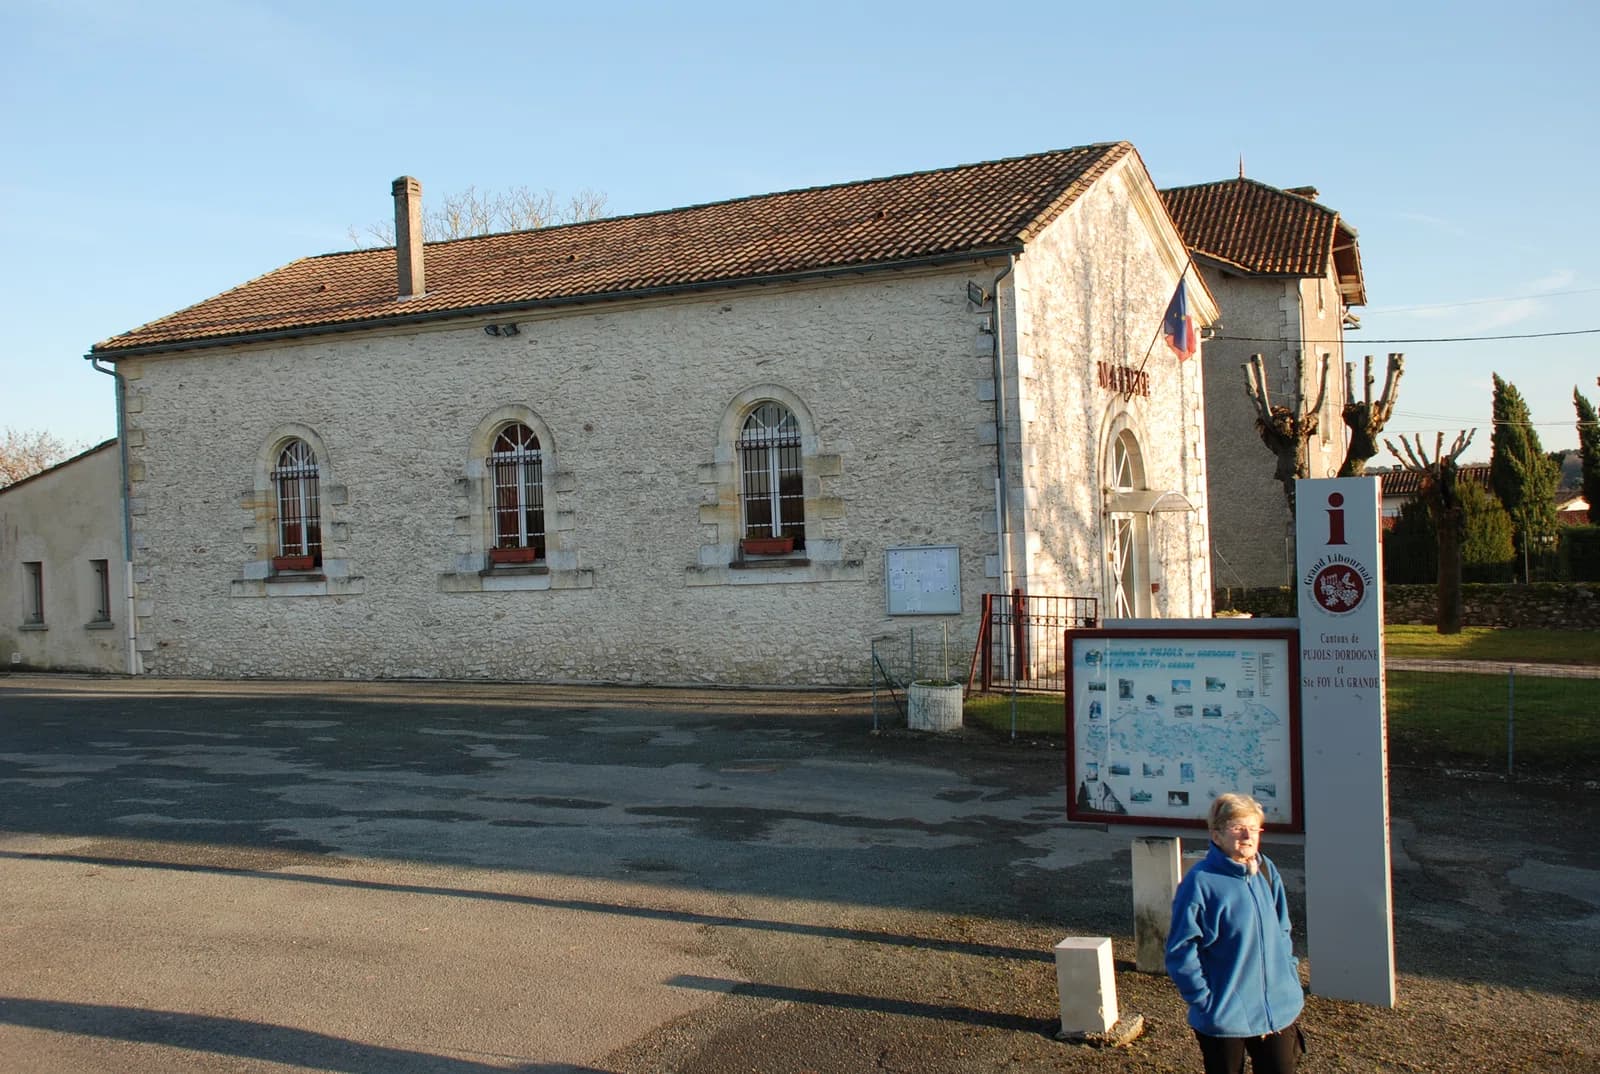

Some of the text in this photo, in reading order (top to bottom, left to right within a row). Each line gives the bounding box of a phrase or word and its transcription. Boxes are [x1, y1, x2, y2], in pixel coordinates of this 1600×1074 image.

[1097, 361, 1150, 397] MAIRIE
[1304, 553, 1374, 586] Grand Libournais
[1320, 633, 1359, 643] Cantons de
[1317, 677, 1331, 688] FOY
[1334, 677, 1344, 688] LA
[1347, 677, 1379, 688] GRANDE
